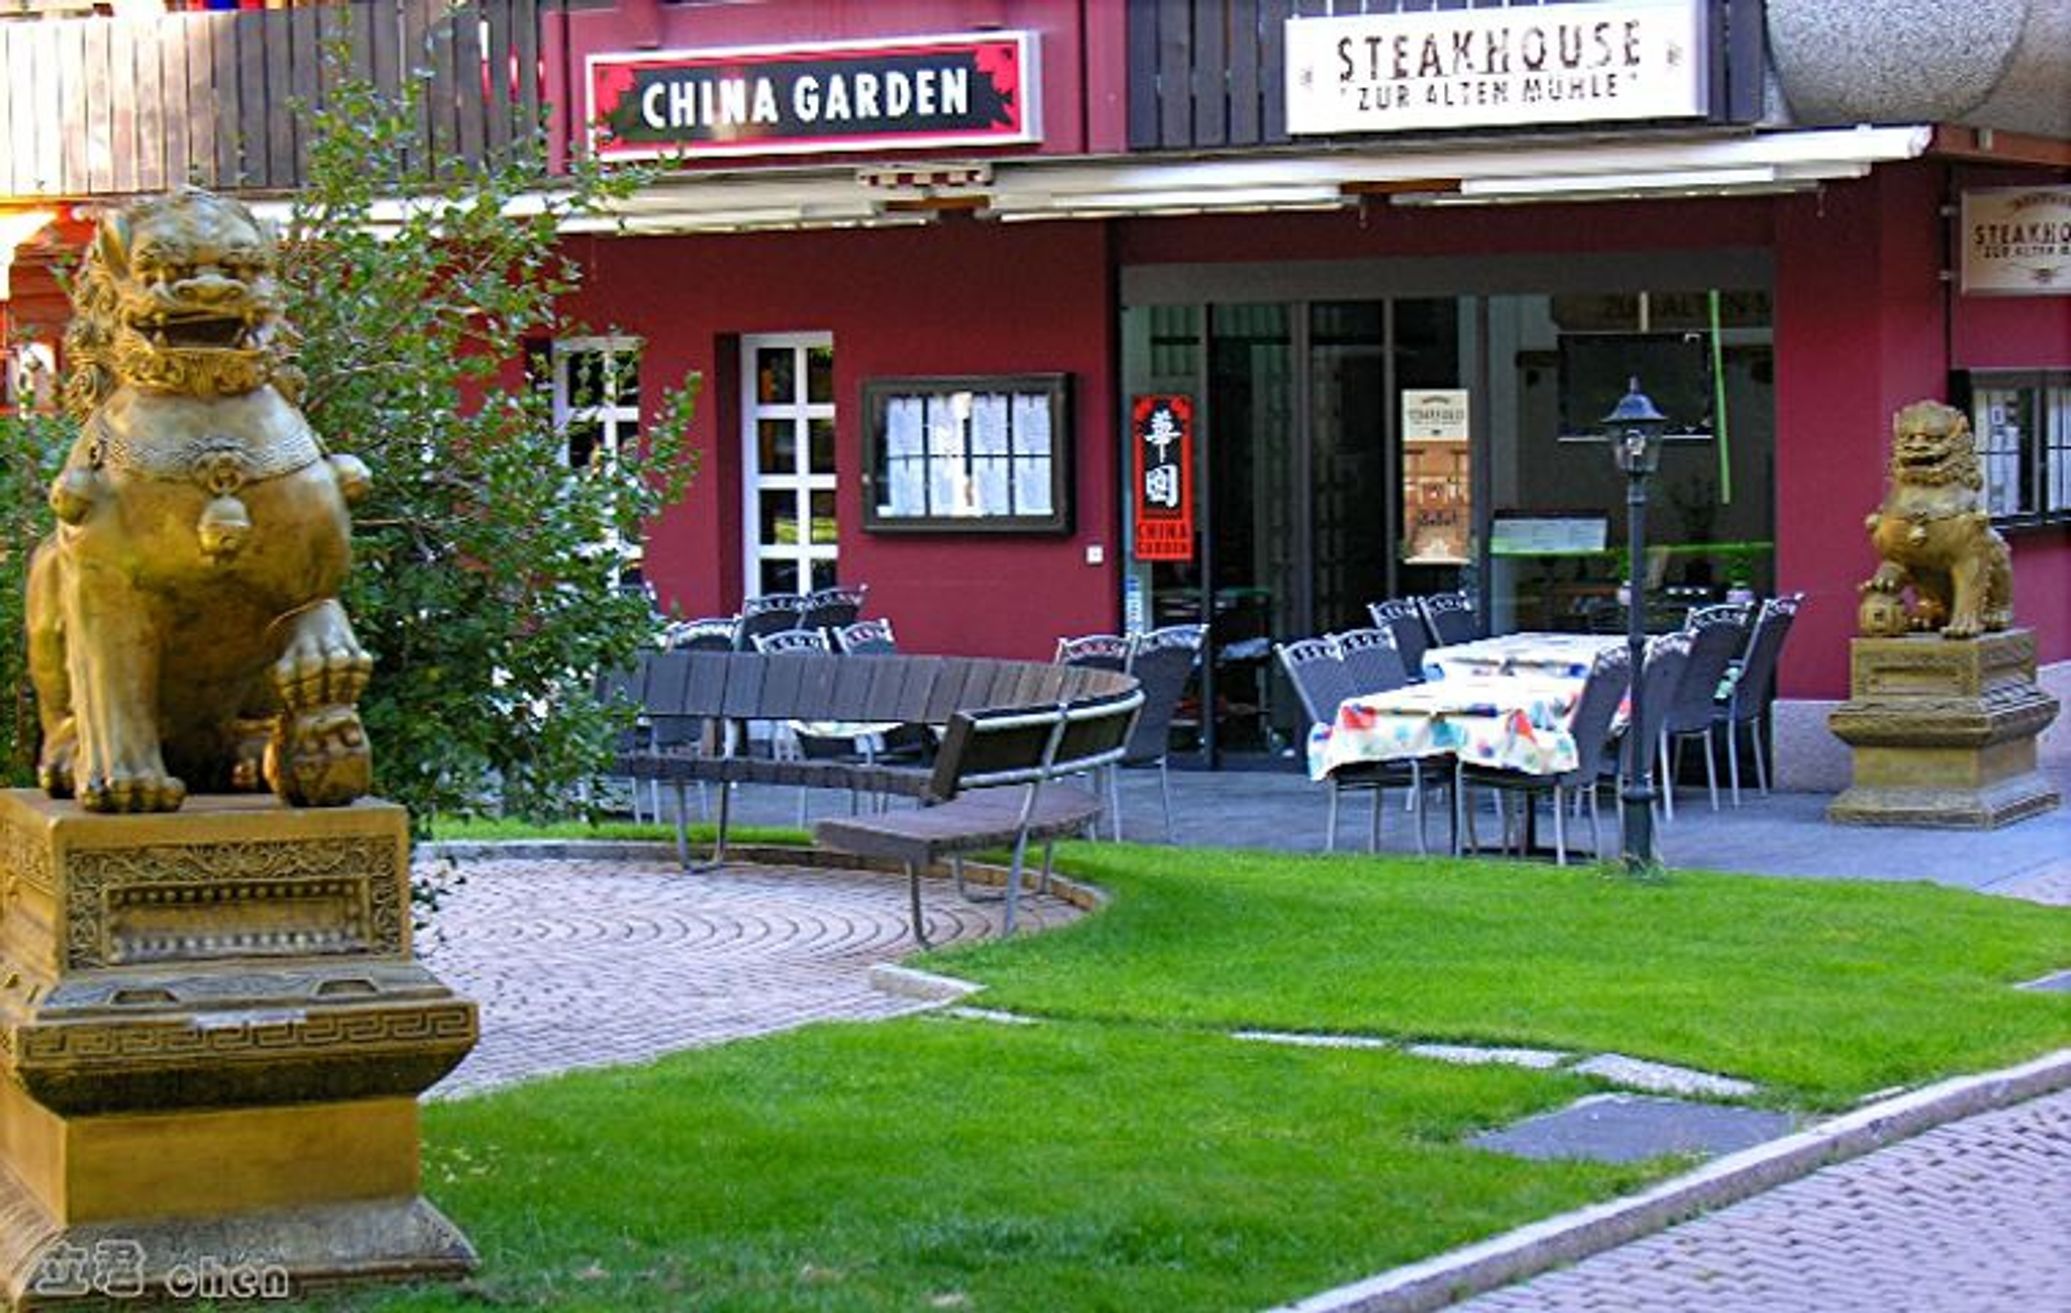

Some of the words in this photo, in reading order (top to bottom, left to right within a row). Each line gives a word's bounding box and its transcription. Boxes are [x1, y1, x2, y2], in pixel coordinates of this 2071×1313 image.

[1337, 20, 1641, 82] STEAKHOUSE
[642, 78, 778, 128] CHINA
[794, 69, 968, 121] GARDEN
[1358, 86, 1411, 111] ZUR
[1425, 81, 1508, 106] ALTEN
